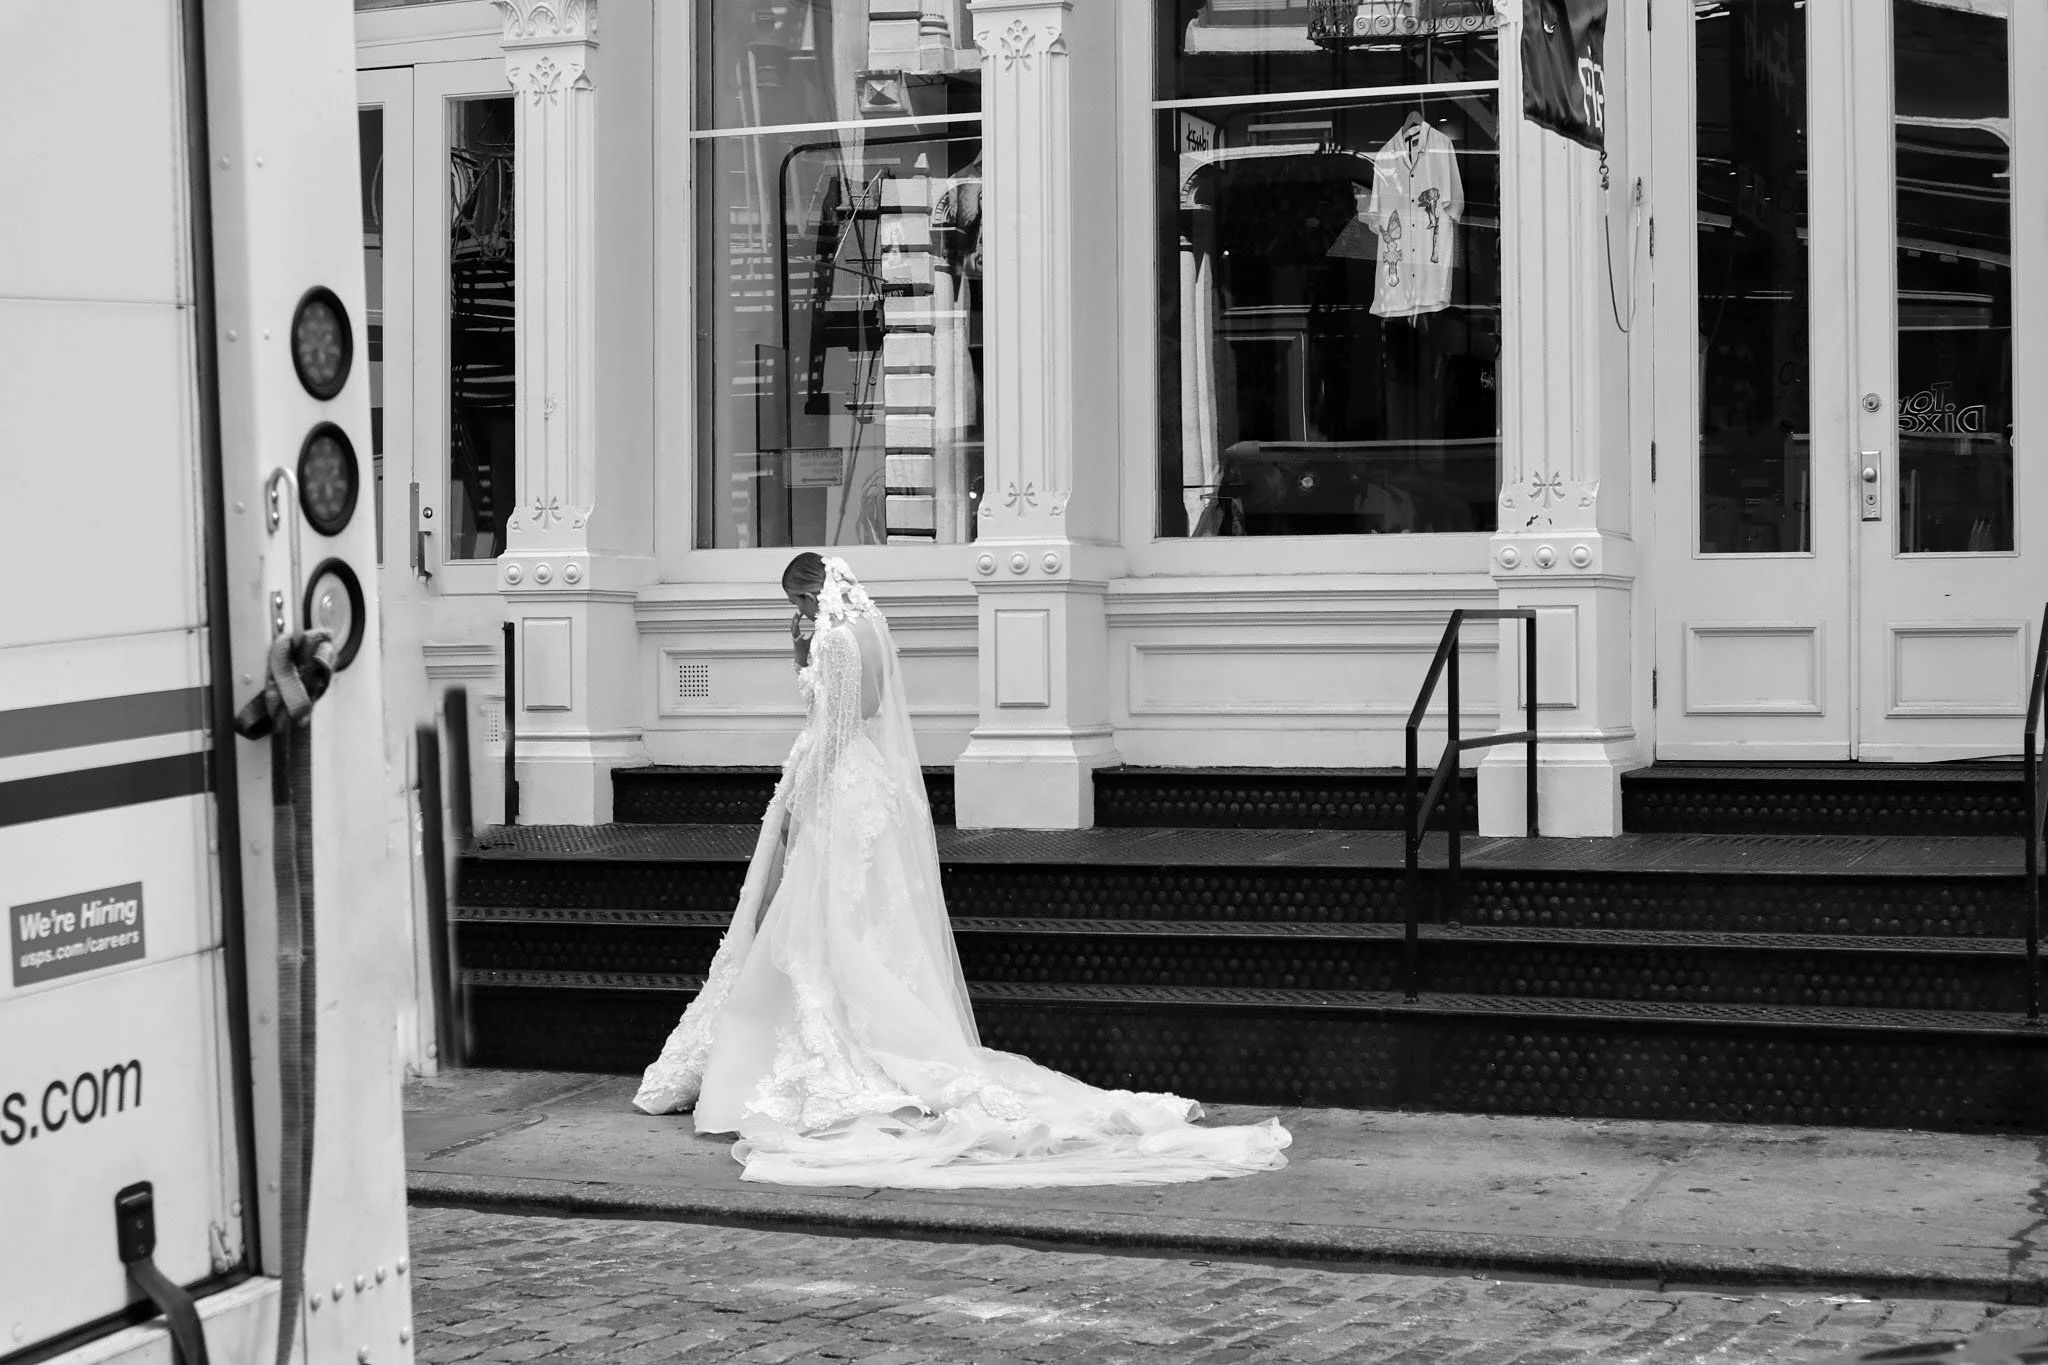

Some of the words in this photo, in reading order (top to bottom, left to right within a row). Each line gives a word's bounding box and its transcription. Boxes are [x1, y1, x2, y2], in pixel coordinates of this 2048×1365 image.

[20, 909, 76, 941] We're
[80, 897, 138, 929] Hiring
[20, 930, 139, 968] usps.com/careers
[0, 1059, 142, 1146] s.com
